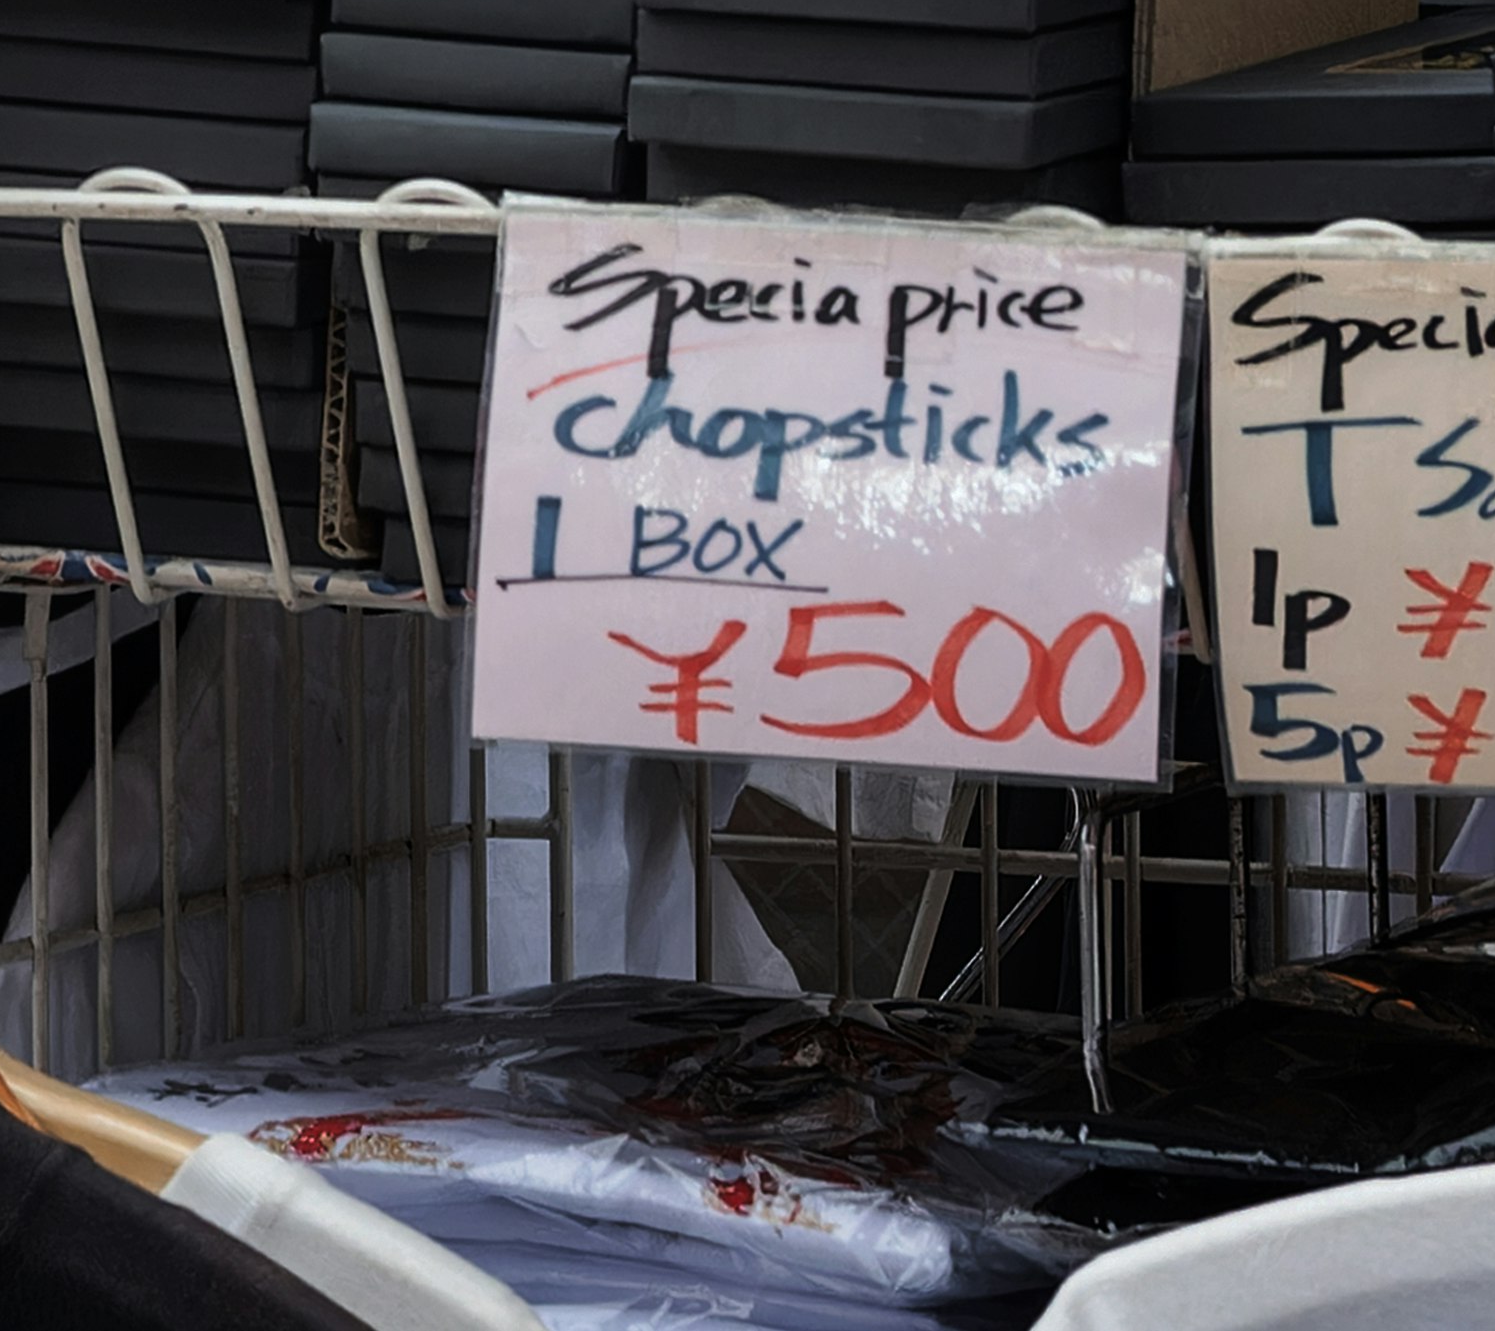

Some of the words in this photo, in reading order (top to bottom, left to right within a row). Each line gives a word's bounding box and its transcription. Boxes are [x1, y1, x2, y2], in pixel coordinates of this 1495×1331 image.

[883, 268, 1086, 378] price
[1240, 415, 1423, 528] T
[630, 505, 805, 581] BOX
[606, 600, 1147, 748] ¥500
